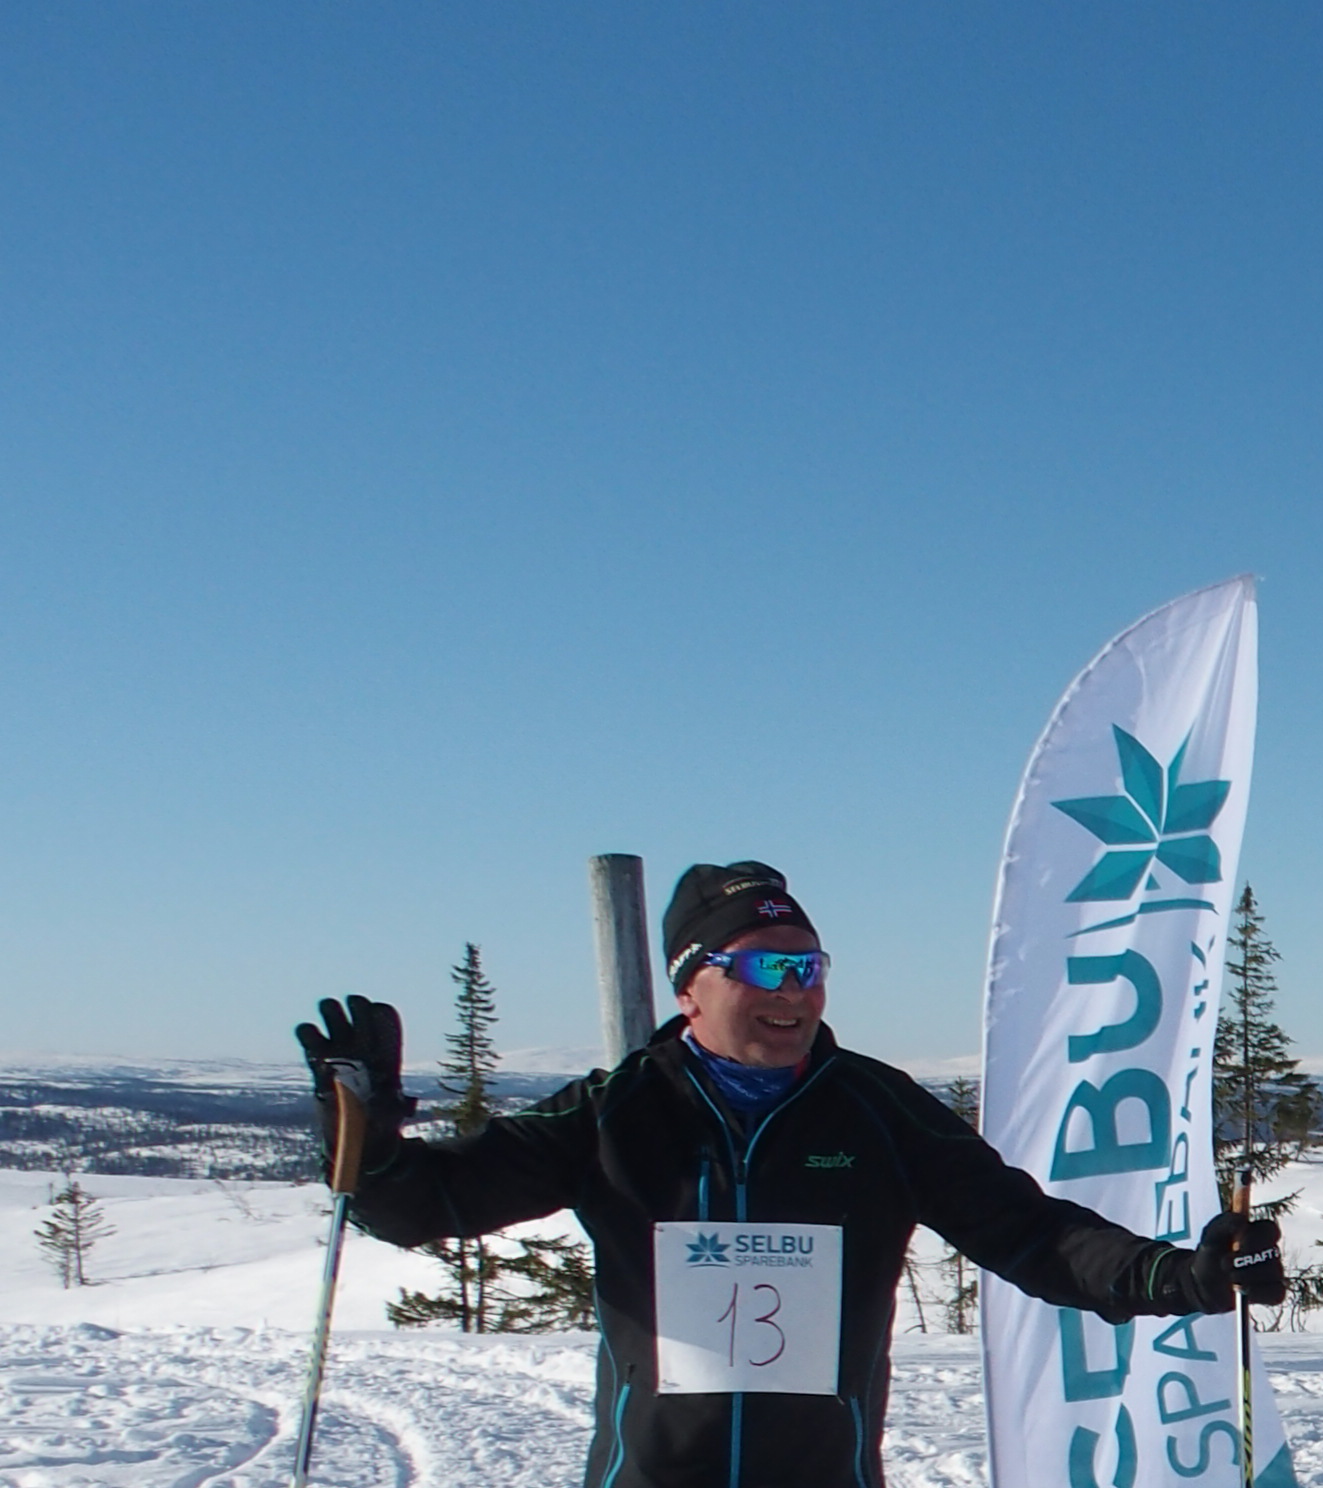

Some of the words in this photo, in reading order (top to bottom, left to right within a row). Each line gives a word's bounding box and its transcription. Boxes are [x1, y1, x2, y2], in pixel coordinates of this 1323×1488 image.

[736, 1233, 814, 1254] SELBU
[735, 1255, 814, 1269] SPAREBANK
[1233, 1249, 1274, 1269] CRAFT
[717, 1283, 786, 1368] 13
